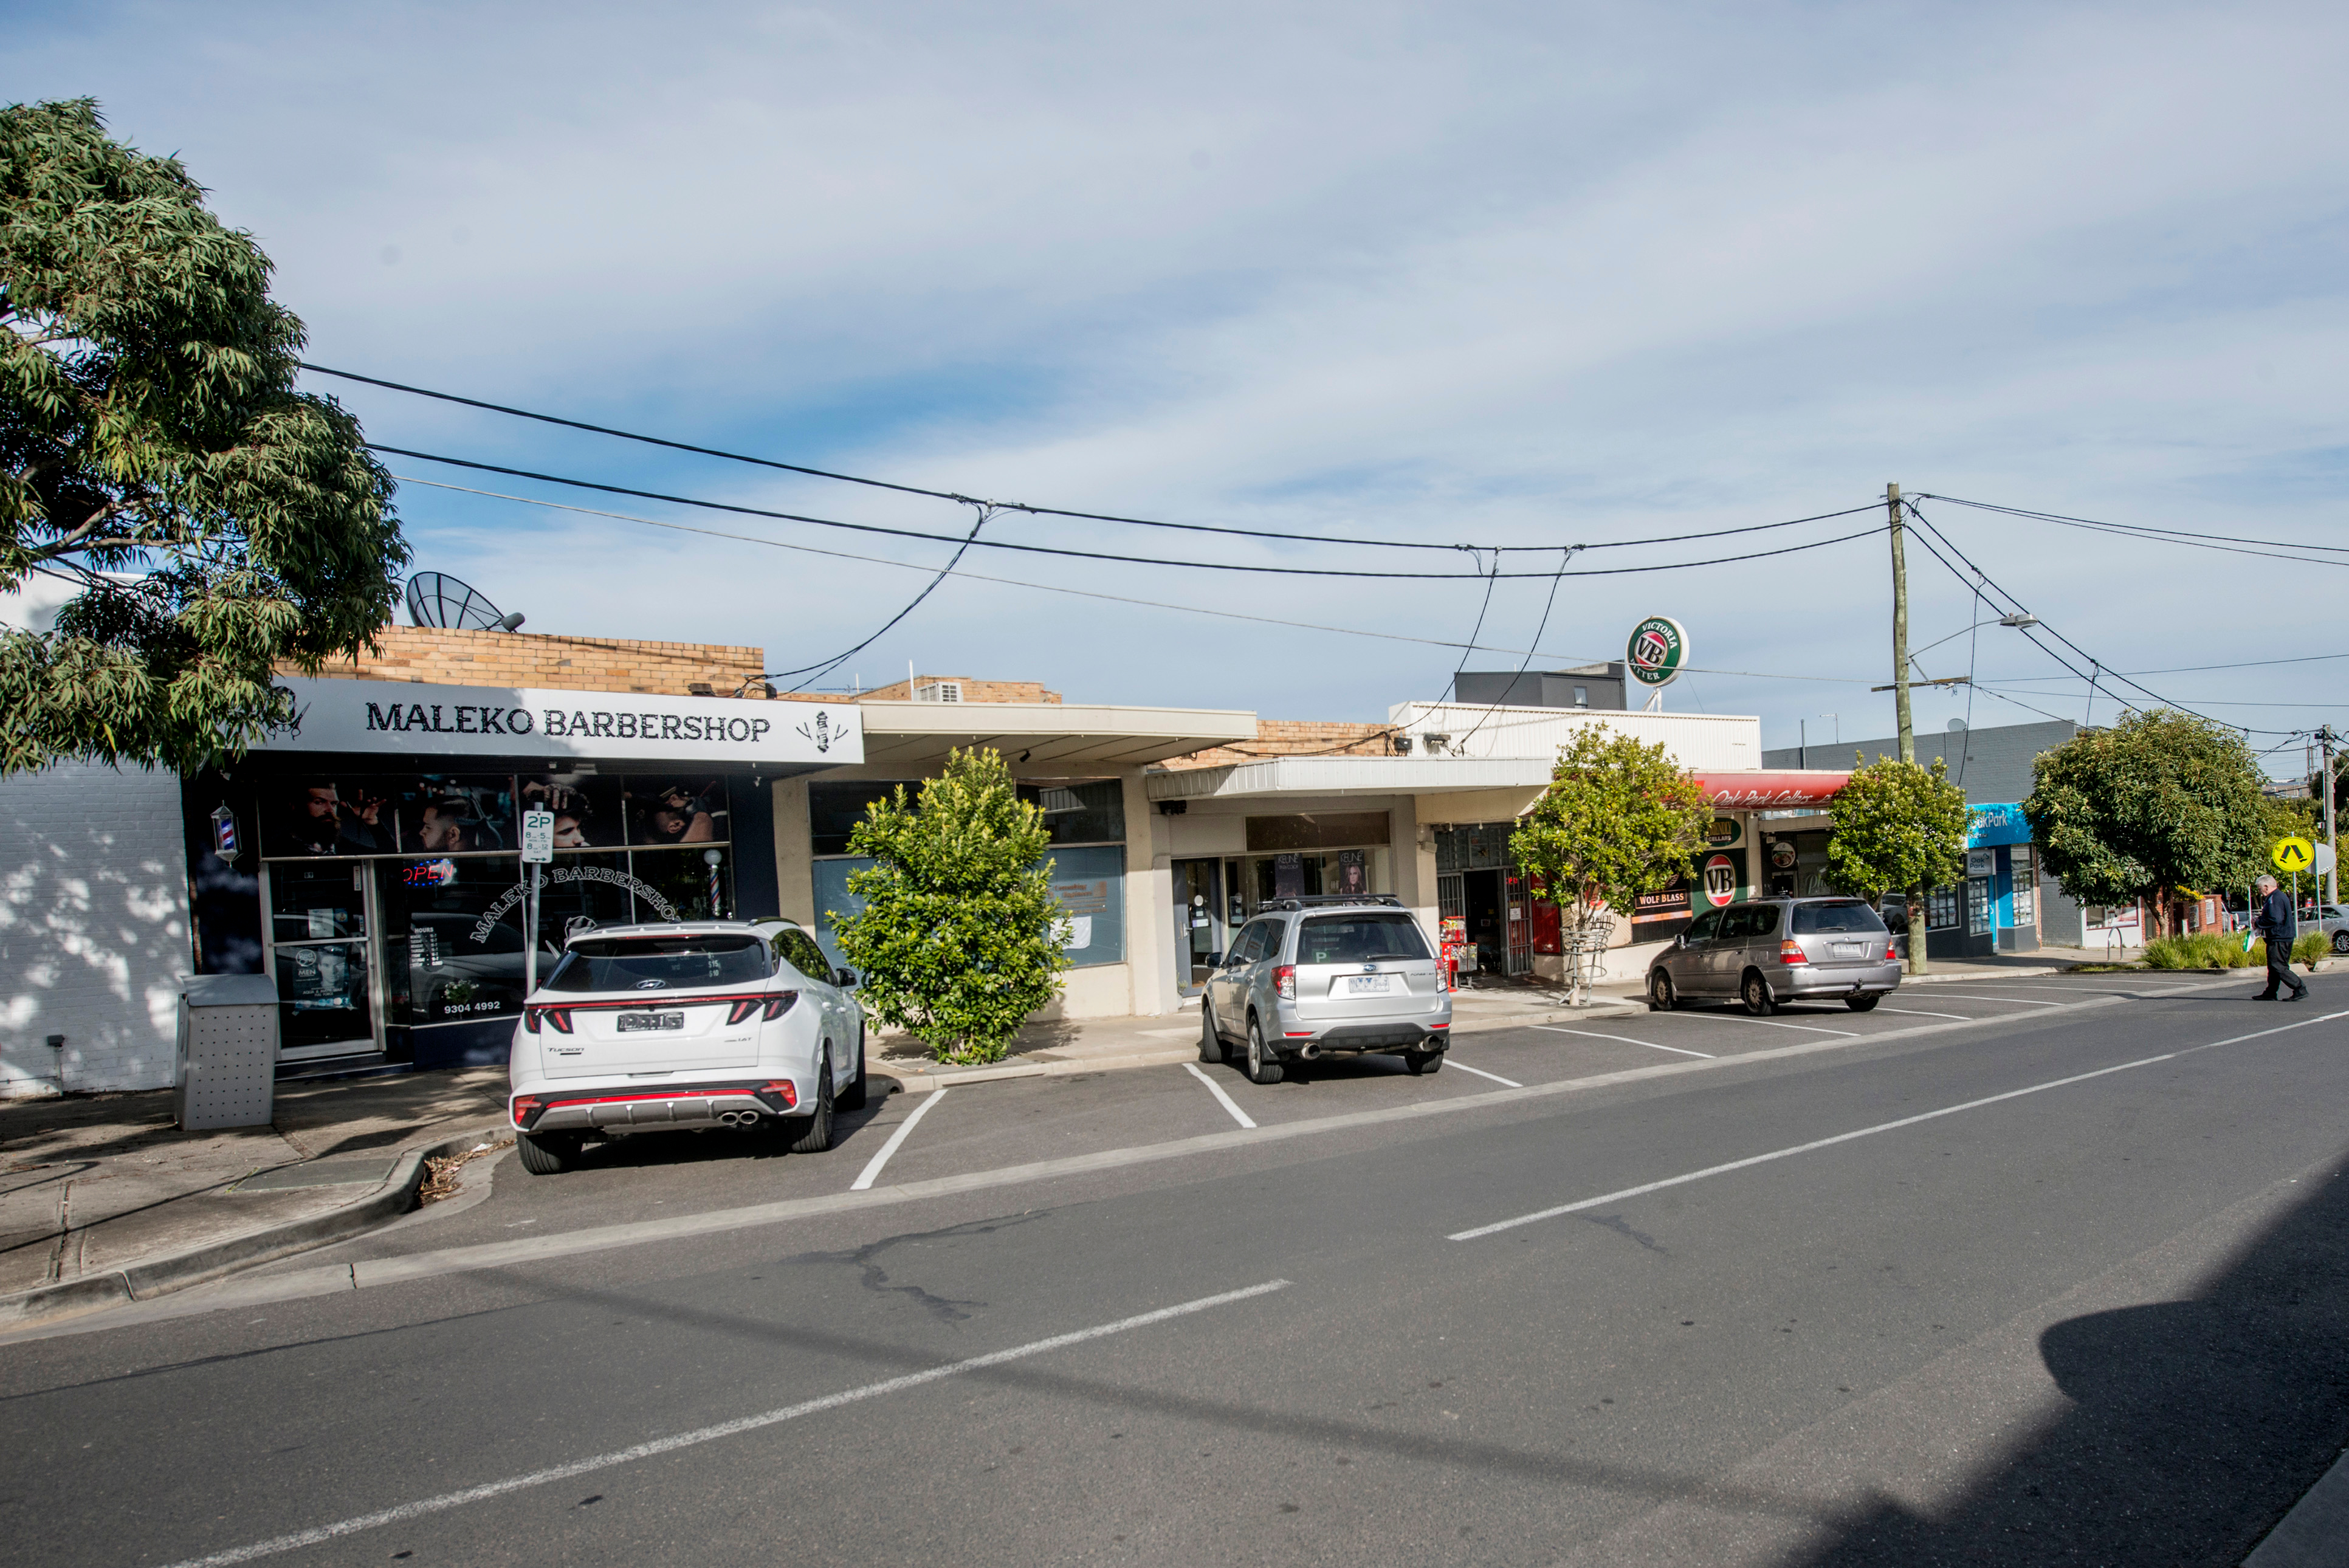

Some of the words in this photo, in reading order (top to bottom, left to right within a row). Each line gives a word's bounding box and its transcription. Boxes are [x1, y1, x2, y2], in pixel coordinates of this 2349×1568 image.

[1642, 622, 1677, 649] VICTORIA
[1637, 637, 1665, 665] VB
[365, 702, 535, 735] MALEKO
[543, 709, 771, 743] BARBERSHOP
[1711, 789, 1741, 806] Oak
[1741, 789, 1772, 806] Park
[1772, 789, 1813, 805] Cellars
[528, 816, 551, 828] 2P
[403, 864, 454, 882] OPEN
[1706, 868, 1734, 895] VB
[552, 867, 682, 923] BARBERSHO
[1639, 895, 1660, 905] WOLF
[1661, 893, 1684, 903] BLASS
[1315, 952, 1327, 963] P
[444, 1003, 471, 1014] 9304
[475, 1001, 500, 1011] 4992
